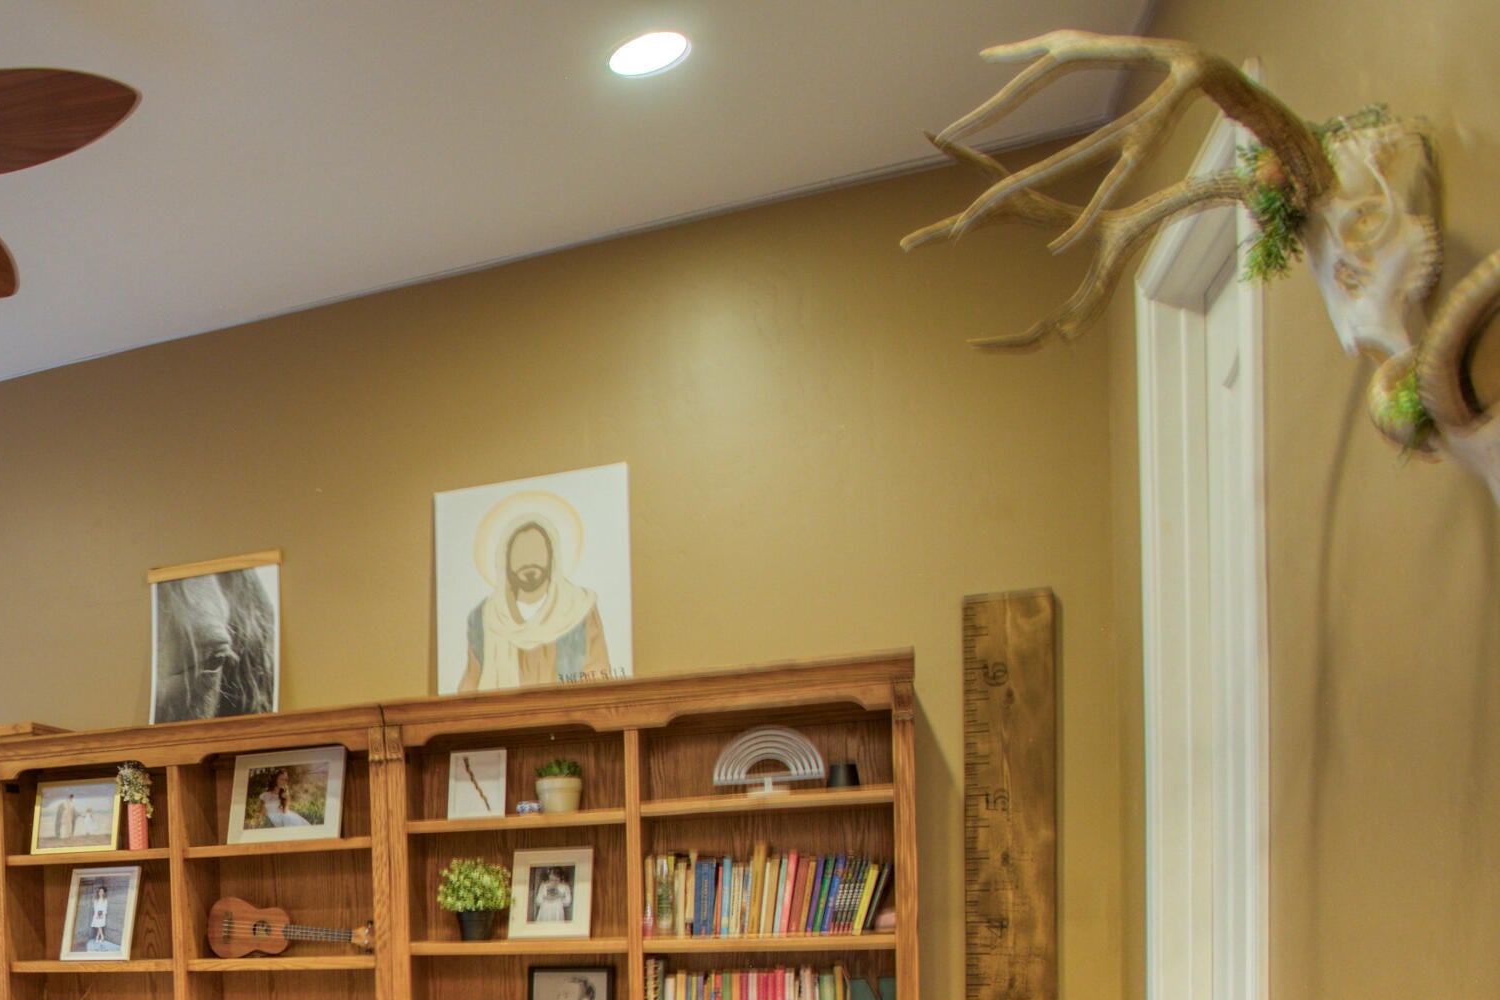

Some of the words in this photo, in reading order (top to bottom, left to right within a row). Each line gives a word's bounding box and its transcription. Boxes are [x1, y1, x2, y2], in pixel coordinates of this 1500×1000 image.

[983, 662, 1008, 687] 6
[985, 787, 1010, 811] 5
[986, 917, 1009, 940] 4
